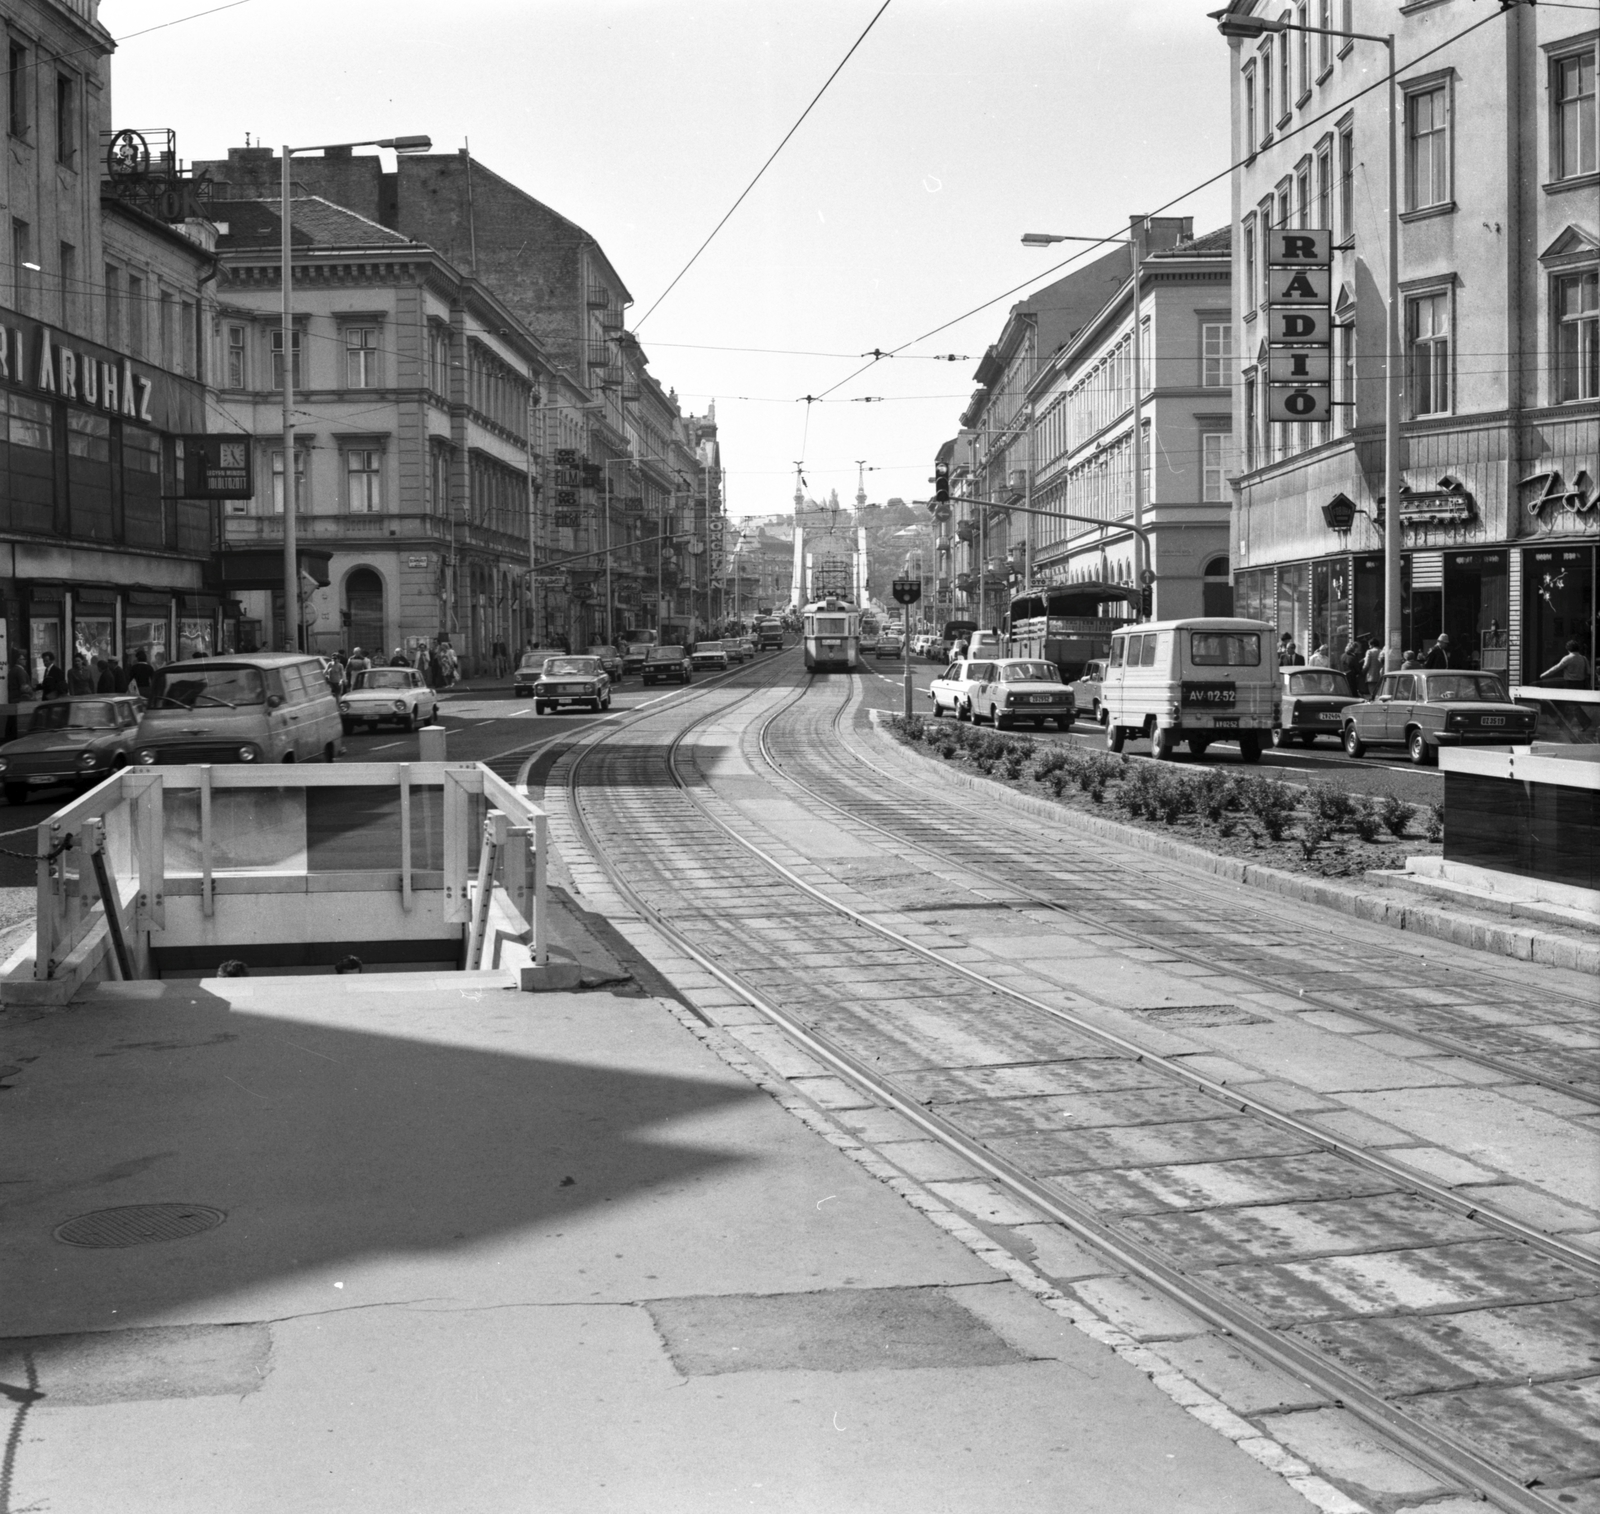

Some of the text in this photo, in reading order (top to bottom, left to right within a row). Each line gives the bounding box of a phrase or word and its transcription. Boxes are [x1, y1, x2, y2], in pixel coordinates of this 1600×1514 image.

[1281, 235, 1319, 416] RÁDIÓ
[37, 326, 152, 422] ÁRUHÁZ
[556, 470, 578, 484] FILM
